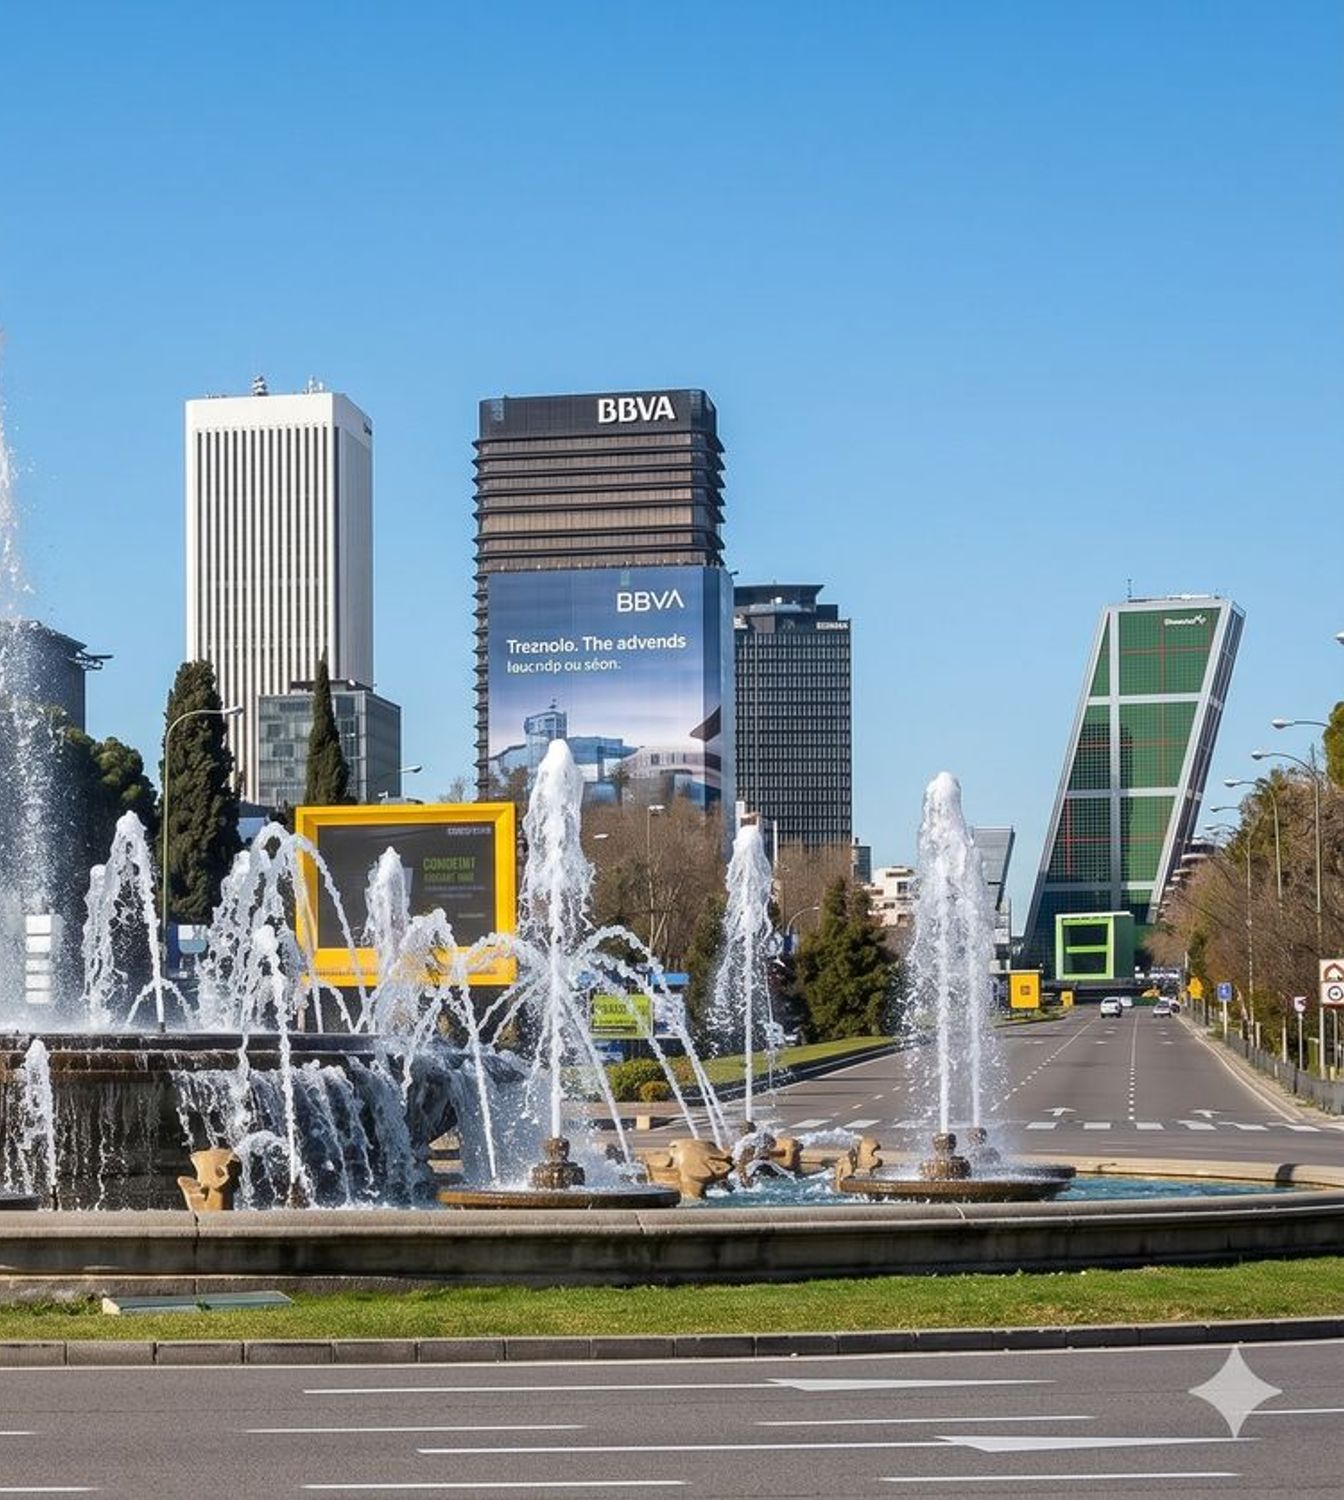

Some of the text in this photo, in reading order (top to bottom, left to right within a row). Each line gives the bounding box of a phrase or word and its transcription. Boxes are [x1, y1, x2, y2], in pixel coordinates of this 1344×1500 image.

[598, 395, 676, 424] BBVA
[616, 588, 685, 613] BBVA
[582, 636, 613, 652] The
[616, 633, 687, 650] advends
[564, 660, 582, 672] ou
